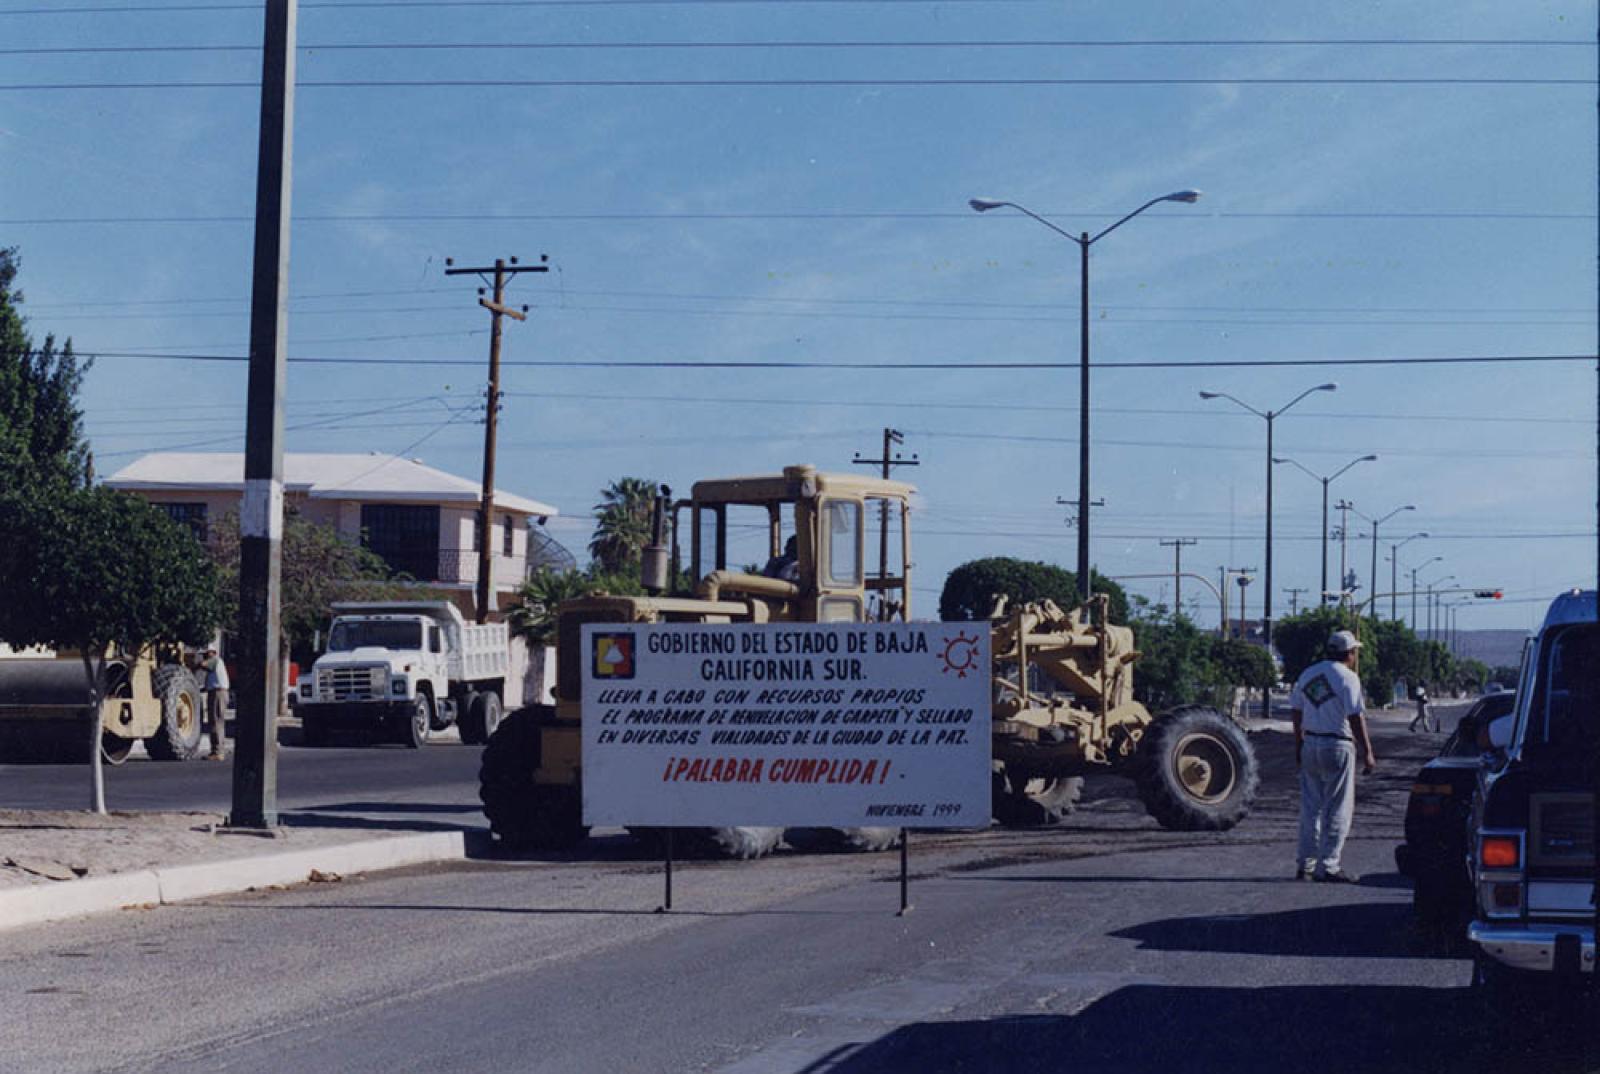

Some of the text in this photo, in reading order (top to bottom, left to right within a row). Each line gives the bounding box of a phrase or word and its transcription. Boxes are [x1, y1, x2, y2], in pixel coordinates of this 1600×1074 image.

[648, 632, 929, 654] GOBIERNO DEL ESTADO DE BAJA
[701, 659, 867, 681] CALIFORNIA SUR.
[597, 688, 926, 705] LLEVA A CABO CON RECURSOS PROPIOS
[602, 708, 622, 724] EL
[624, 708, 705, 724] PROGRAMA
[707, 708, 728, 724] DE
[820, 708, 841, 725] DE
[842, 708, 898, 725] CARPETA
[902, 708, 914, 725] Y
[916, 708, 973, 724] SELLADO
[598, 729, 969, 745] EN DIVERSAS VIALIDADES DE LA CIUDAD DE LA PAZ.
[663, 756, 765, 783] ¡PALABRA
[932, 803, 962, 817] 1999
